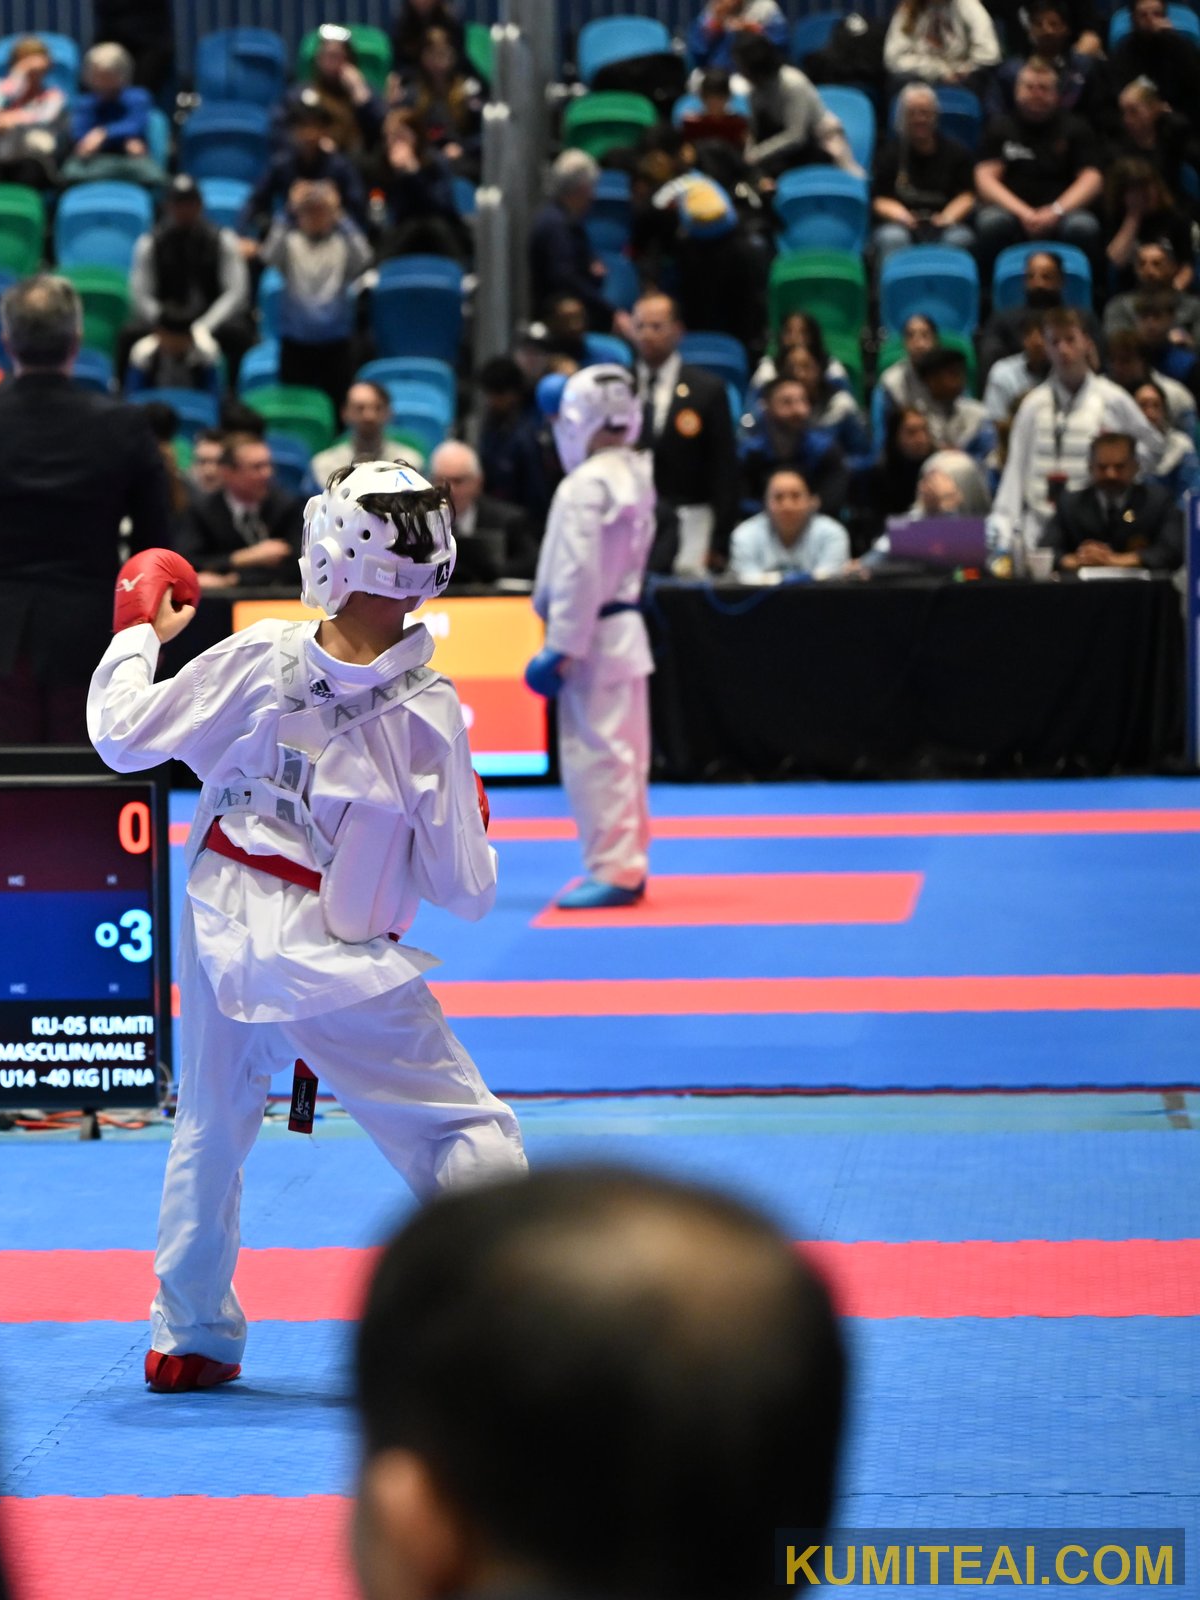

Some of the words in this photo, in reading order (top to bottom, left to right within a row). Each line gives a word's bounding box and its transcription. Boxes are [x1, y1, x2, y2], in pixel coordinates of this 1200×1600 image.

[118, 801, 150, 855] 0
[31, 1016, 88, 1036] KU-05
[0, 1068, 37, 1088] U14
[39, 1068, 71, 1088] -40
[72, 1068, 100, 1088] KG
[112, 1068, 155, 1087] FINA
